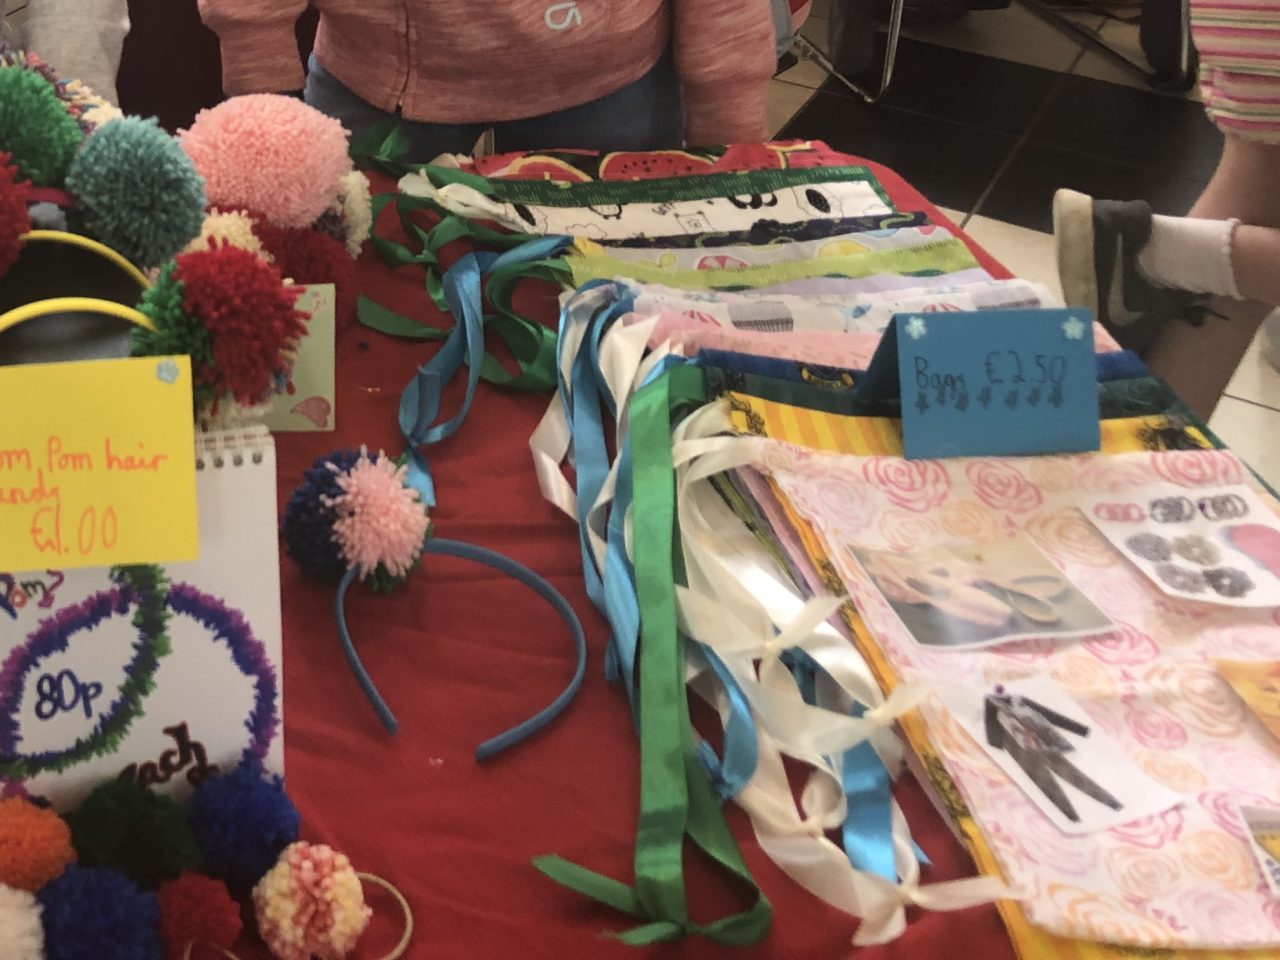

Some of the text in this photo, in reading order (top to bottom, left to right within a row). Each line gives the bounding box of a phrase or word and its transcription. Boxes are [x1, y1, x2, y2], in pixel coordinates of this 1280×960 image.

[47, 435, 93, 472] Pom
[105, 437, 168, 471] hair
[31, 506, 118, 555] £1.00
[35, 668, 104, 719] 80p
